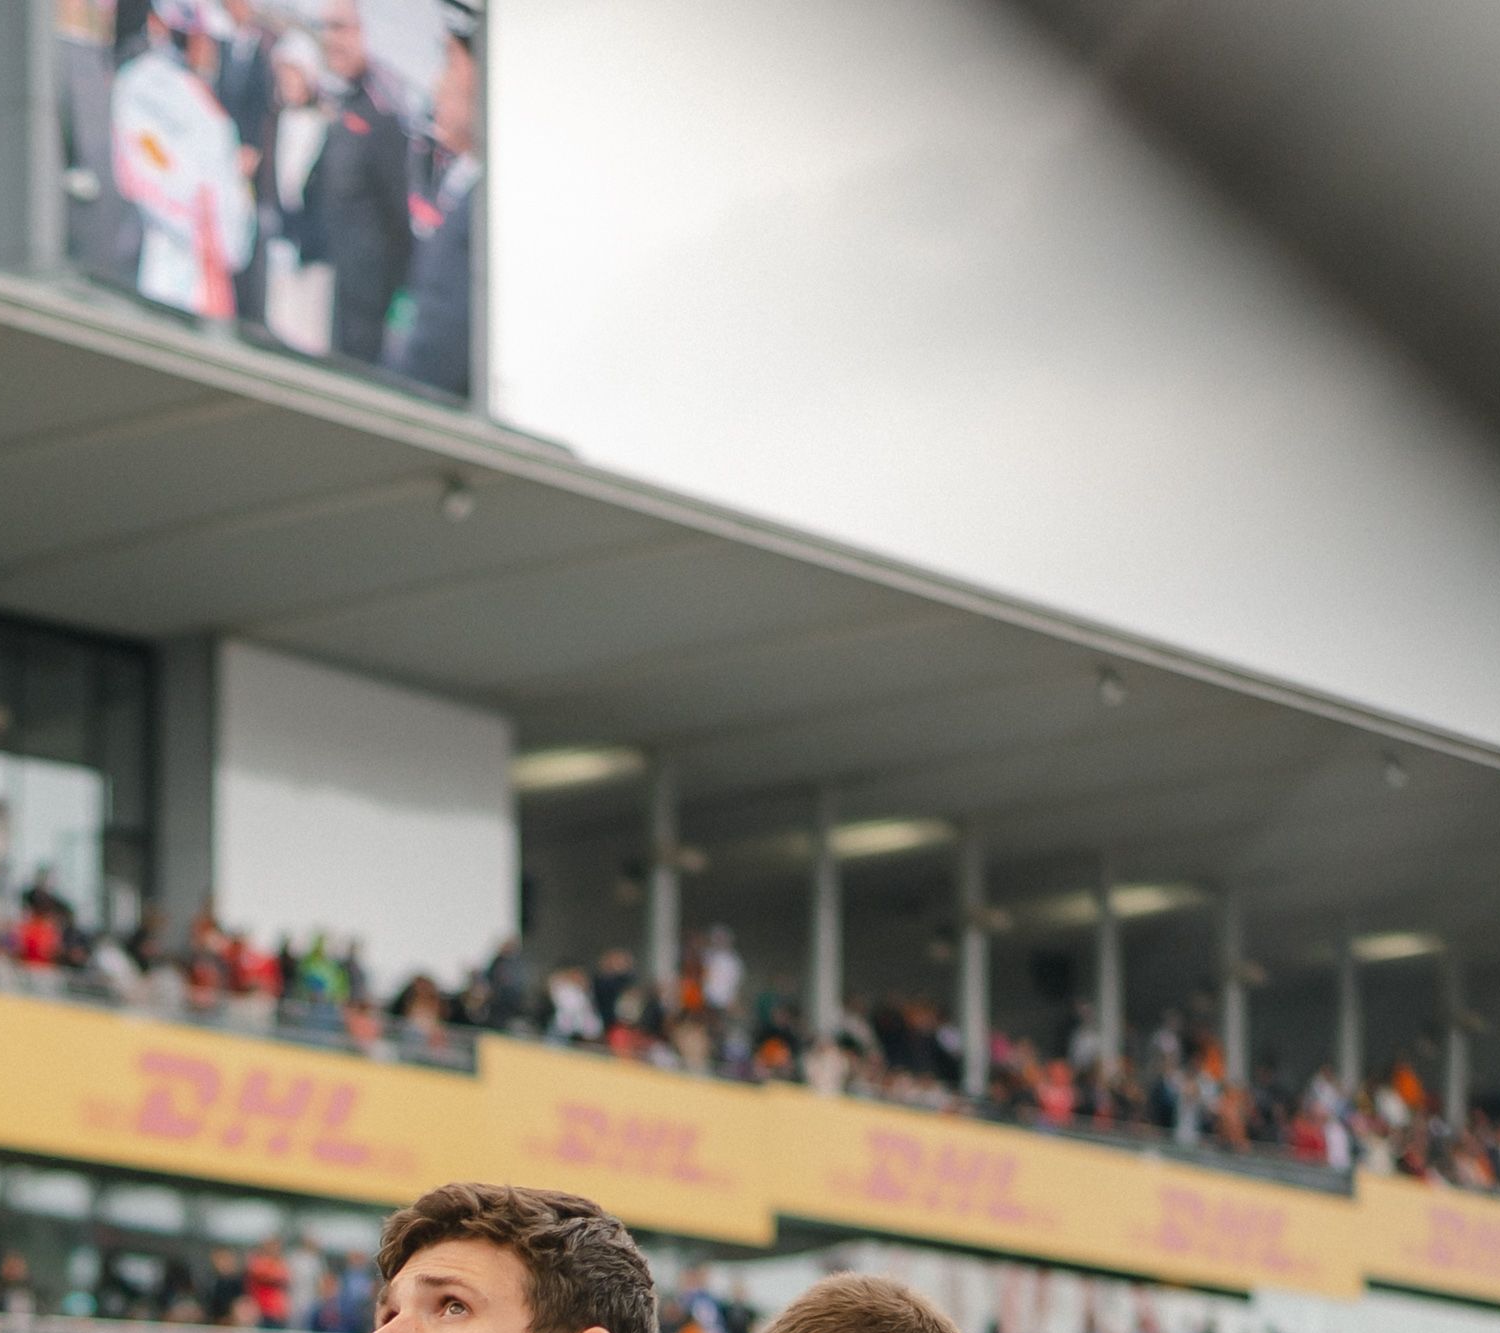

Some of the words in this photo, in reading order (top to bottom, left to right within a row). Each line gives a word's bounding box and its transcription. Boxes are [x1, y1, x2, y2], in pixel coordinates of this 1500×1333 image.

[133, 1049, 371, 1164] DHL
[552, 1102, 706, 1182] DHL
[861, 1129, 1031, 1222] DHL
